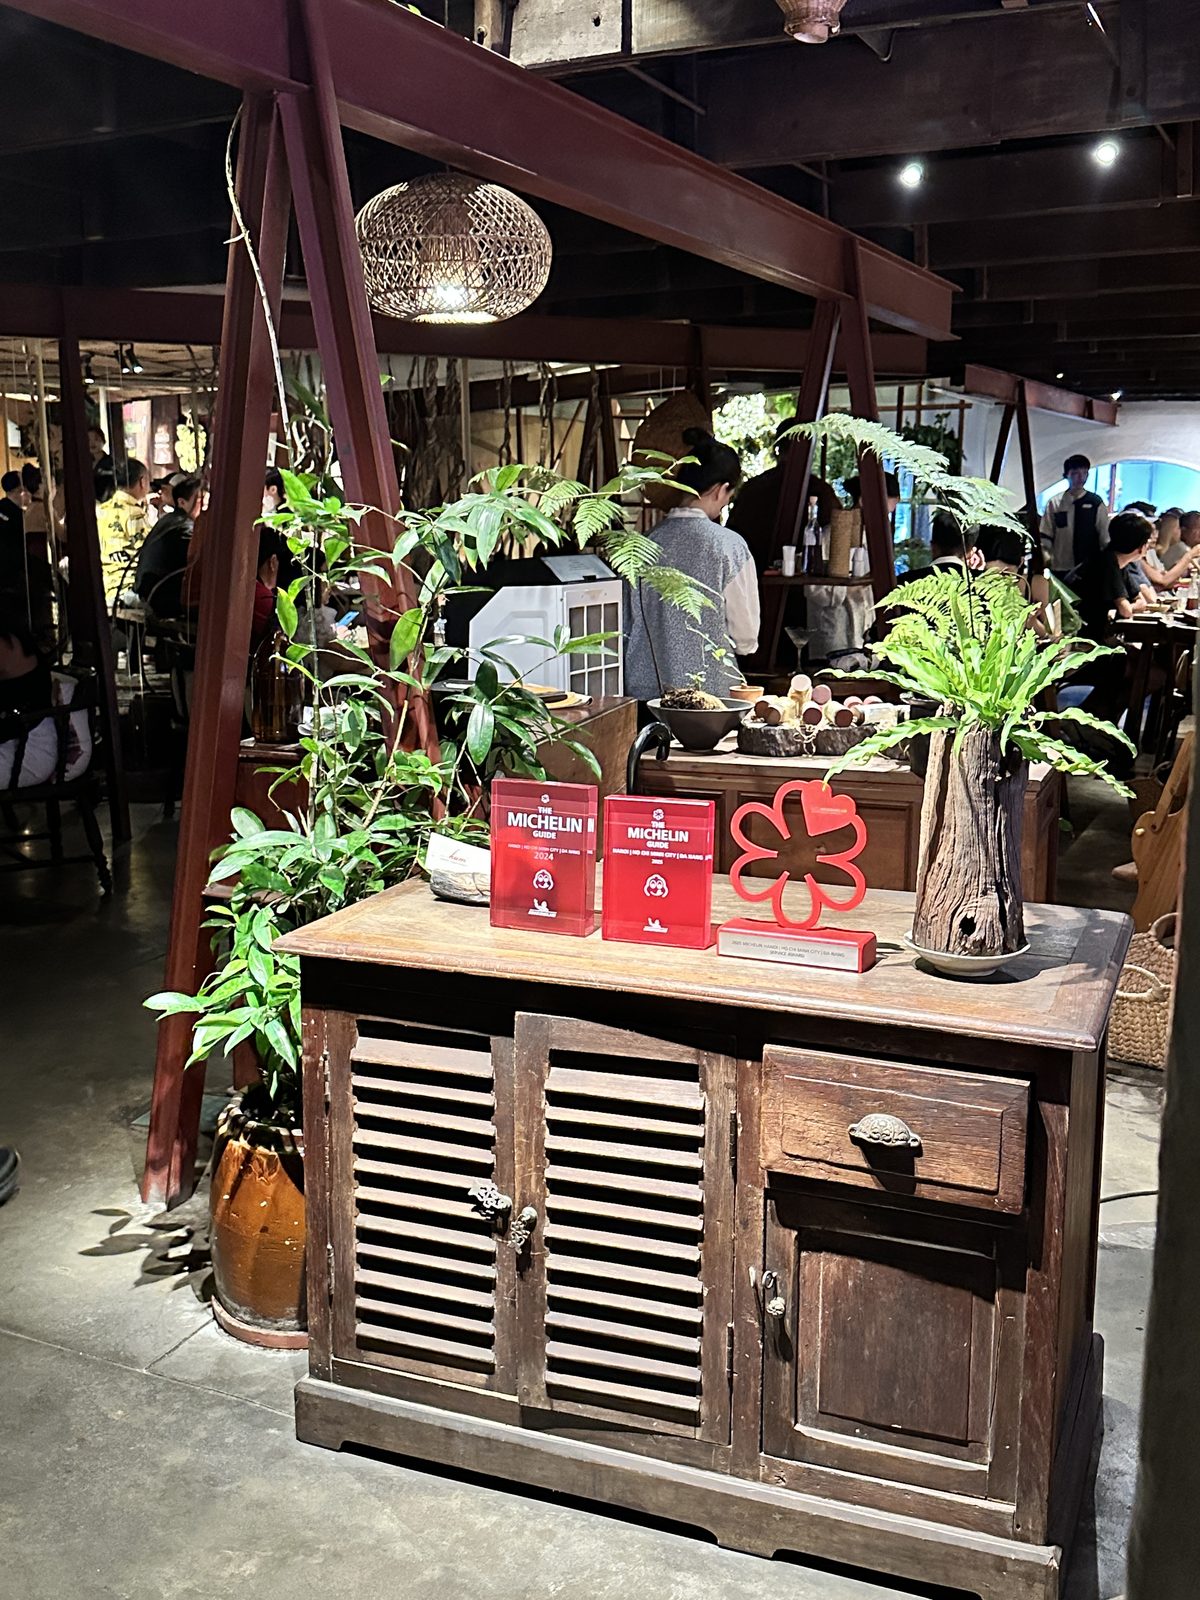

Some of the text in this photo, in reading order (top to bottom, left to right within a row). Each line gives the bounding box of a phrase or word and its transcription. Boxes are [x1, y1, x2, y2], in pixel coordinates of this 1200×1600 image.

[537, 806, 553, 815] THE
[507, 811, 583, 834] MICHELIN
[651, 820, 666, 829] THE
[532, 830, 557, 840] GUIDE
[627, 827, 689, 843] MICHELIN
[646, 841, 669, 850] GUIDE
[533, 851, 554, 861] 2024
